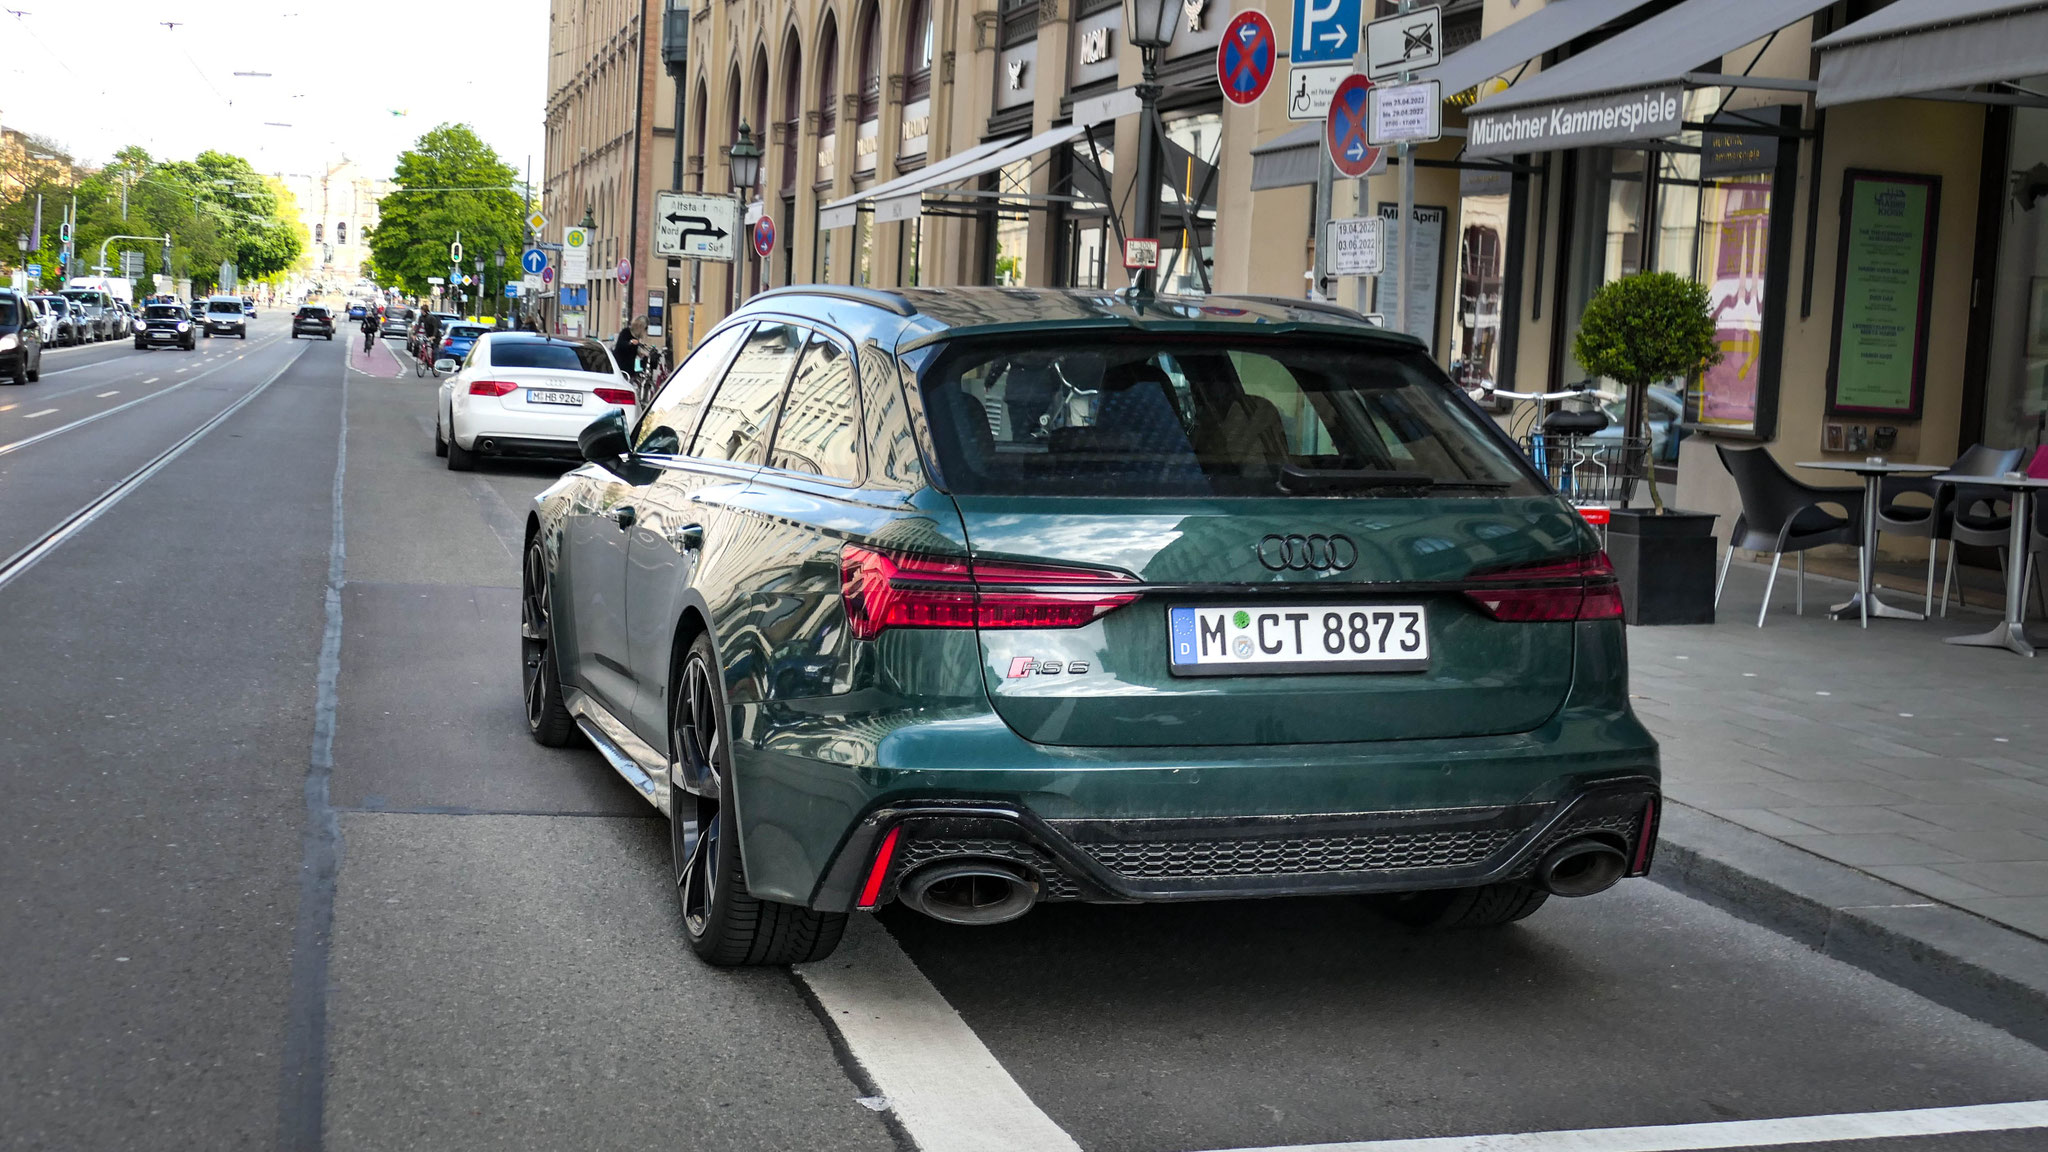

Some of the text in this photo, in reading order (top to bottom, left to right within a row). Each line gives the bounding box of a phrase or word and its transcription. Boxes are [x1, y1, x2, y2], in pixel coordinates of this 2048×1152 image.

[1302, 0, 1341, 51] P
[1081, 27, 1109, 65] MCM
[1472, 92, 1676, 145] Münchner Kammerspiele
[1412, 210, 1440, 224] April
[661, 225, 679, 235] Nord
[1339, 222, 1376, 236] 19.04.2022
[1338, 238, 1375, 251] 03.06.2022
[533, 392, 581, 404] M HB 9264
[1199, 611, 1421, 657] M CT 8873
[1180, 642, 1190, 655] D
[1020, 660, 1091, 675] RS 6
